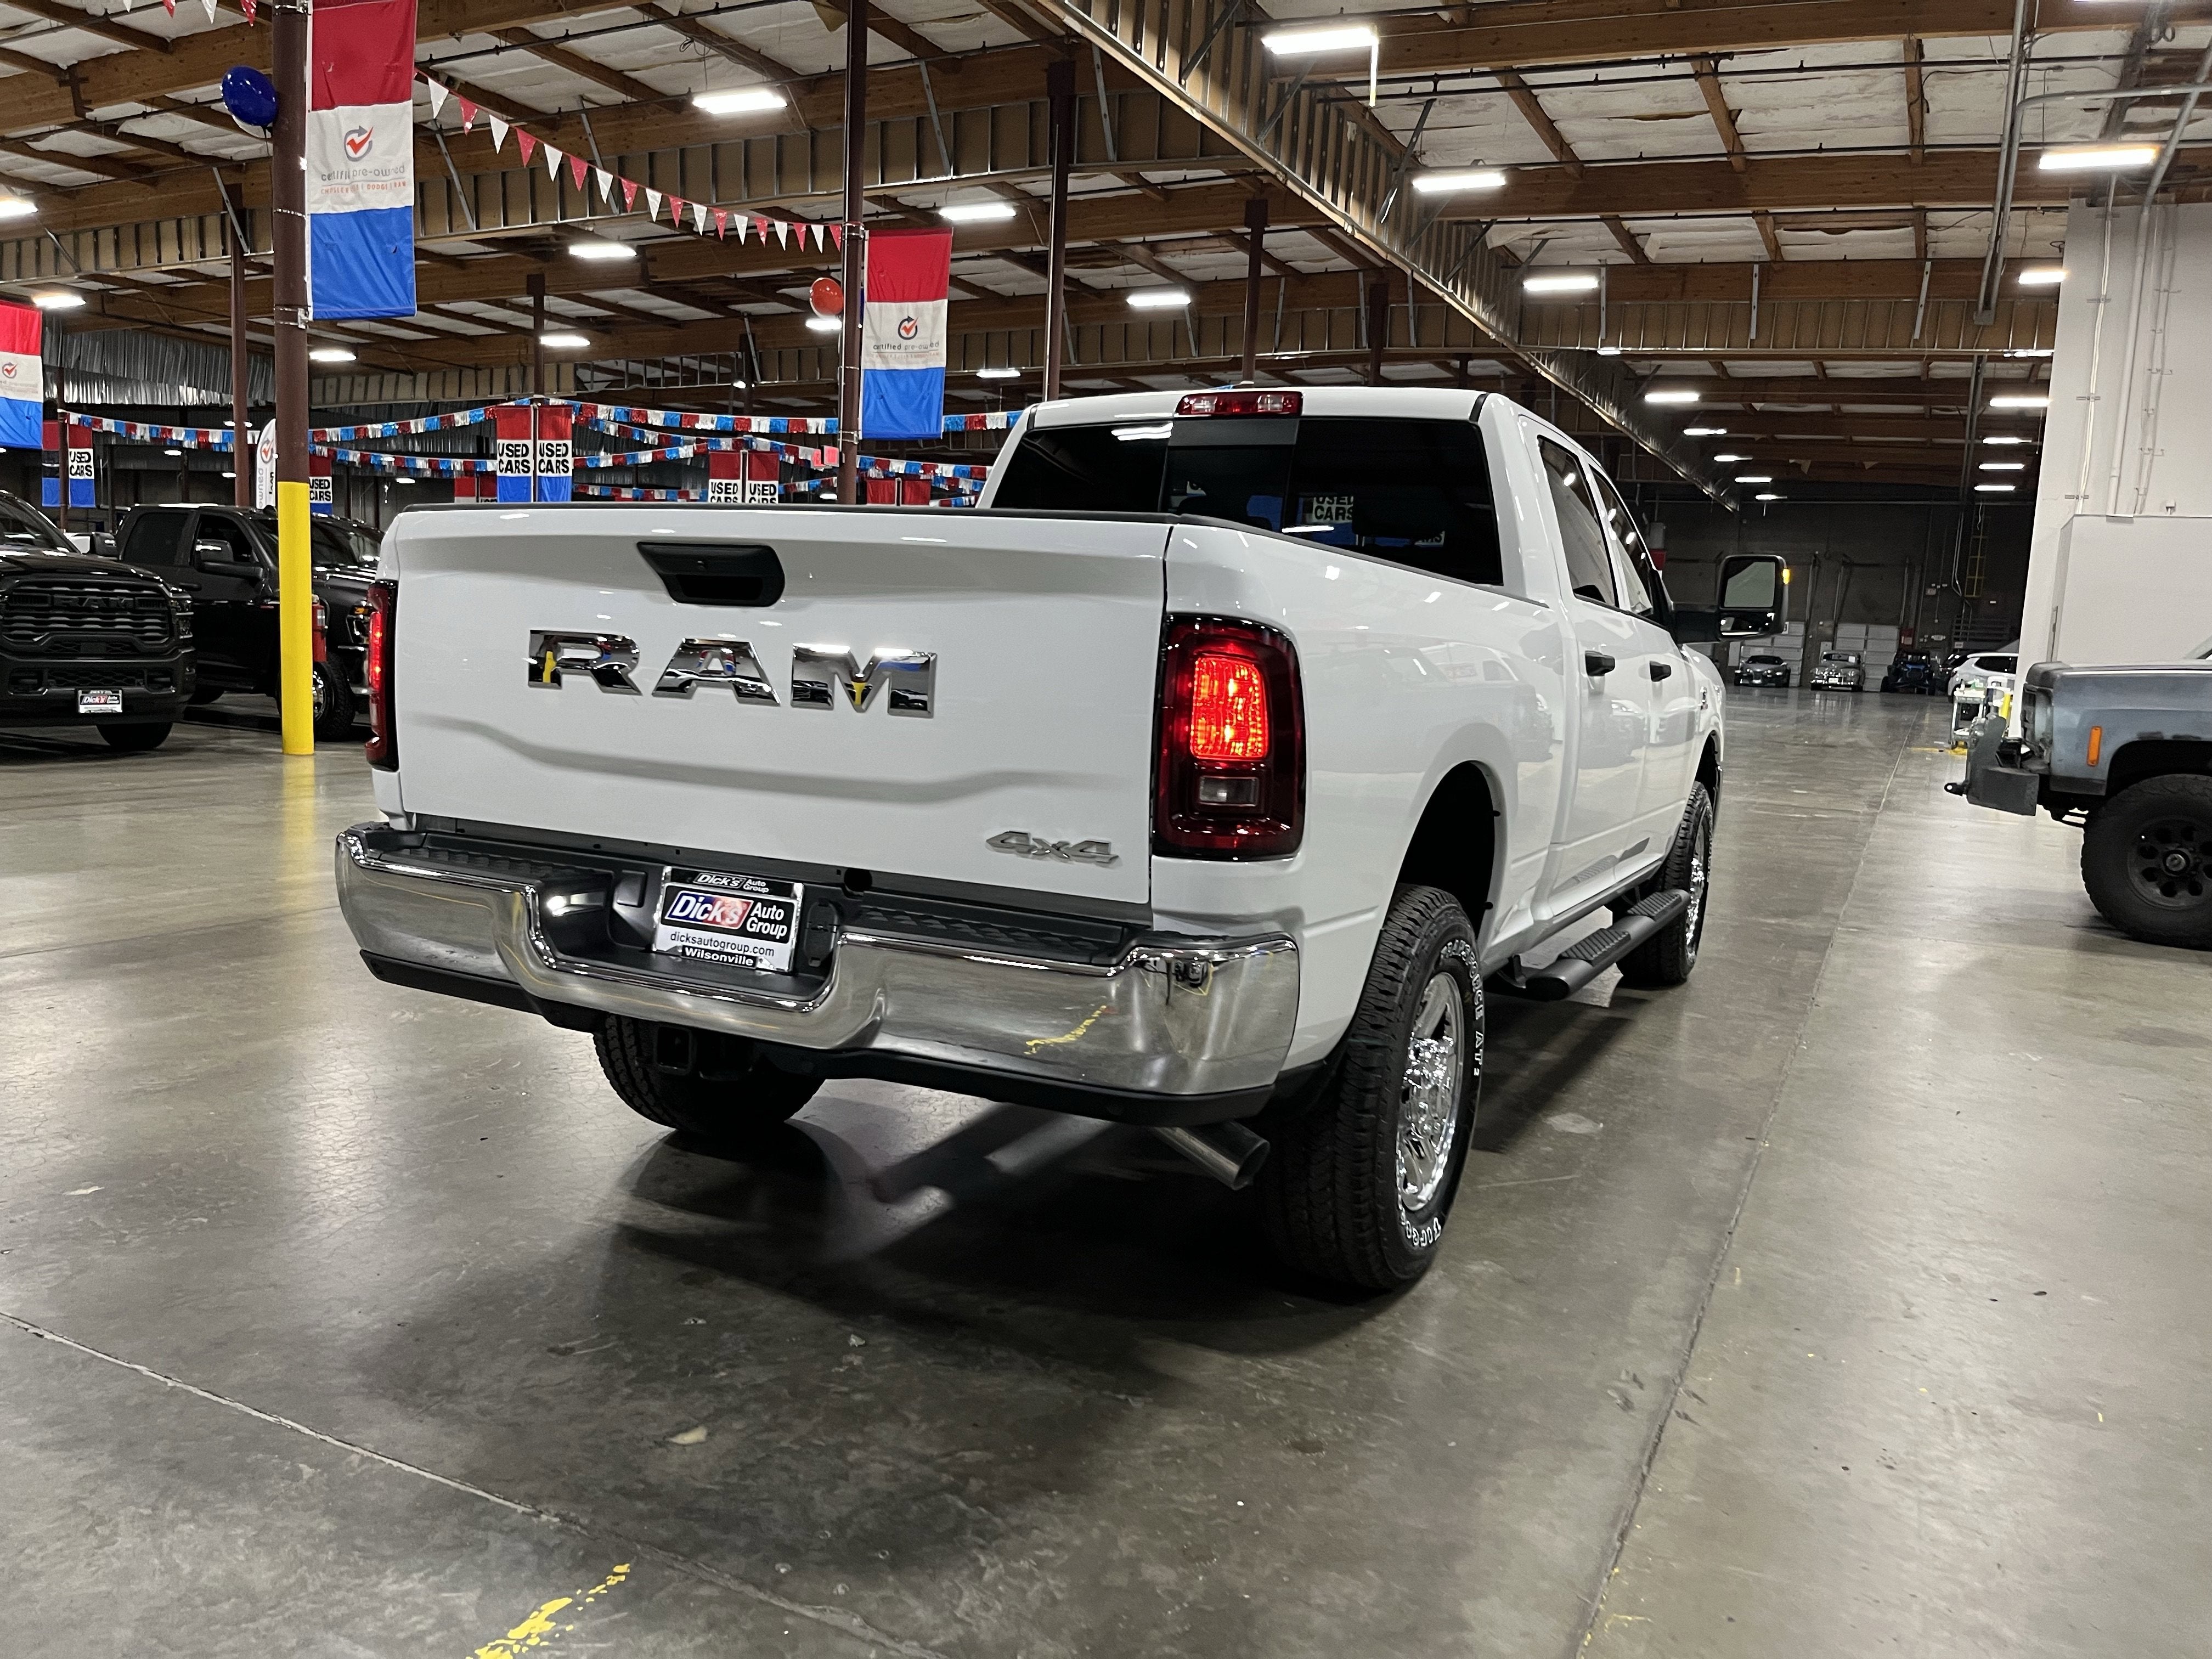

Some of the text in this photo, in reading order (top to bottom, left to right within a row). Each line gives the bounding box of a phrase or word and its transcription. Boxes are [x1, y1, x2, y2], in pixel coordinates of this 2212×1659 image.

[904, 340, 939, 352] pre-owed
[70, 451, 92, 462] USED
[498, 443, 529, 458] USED
[539, 443, 569, 458] USED
[70, 465, 93, 477] CARS
[498, 459, 531, 473] CARS
[538, 459, 569, 473] CARS
[710, 482, 738, 495] USED
[749, 483, 777, 496] USED
[1314, 505, 1353, 521] CARS
[528, 629, 937, 719] RAM
[986, 830, 1120, 864] 4x4
[696, 874, 766, 888] Dick's Auto
[743, 884, 769, 893] Group
[672, 895, 785, 924] Dick's Auto
[746, 917, 788, 940] Group
[670, 931, 775, 957] dicksautogroup.com
[684, 947, 754, 967] Wilsonville
